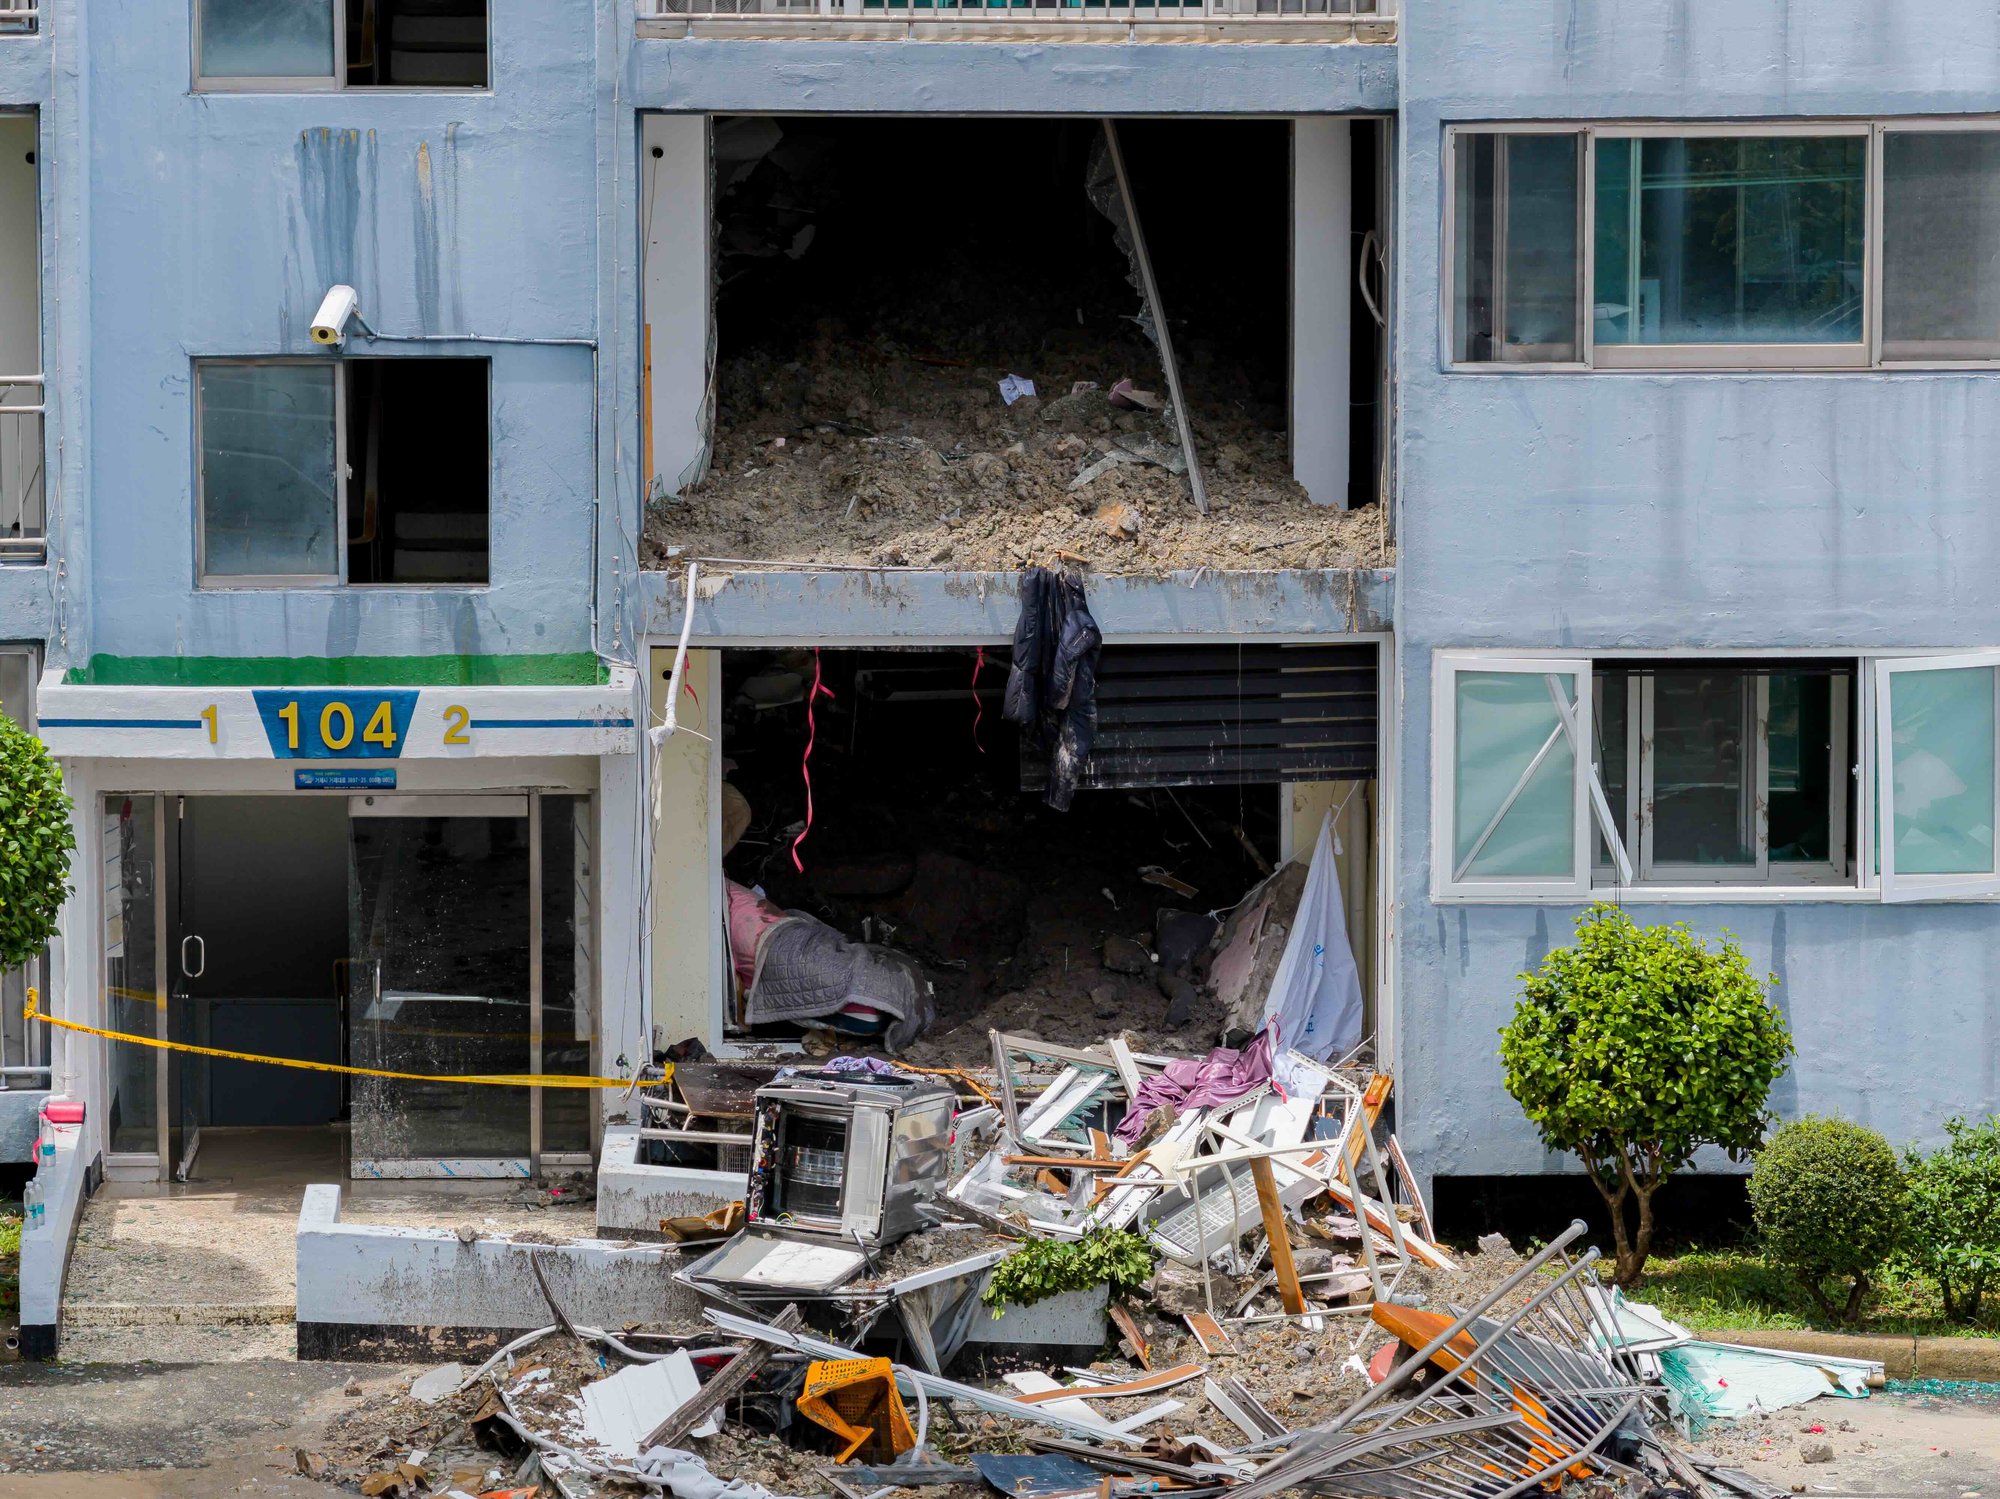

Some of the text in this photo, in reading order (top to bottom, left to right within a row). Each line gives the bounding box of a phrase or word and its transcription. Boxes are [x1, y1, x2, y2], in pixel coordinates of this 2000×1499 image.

[202, 704, 218, 744] 1
[279, 701, 397, 750] 104
[443, 705, 470, 744] 2
